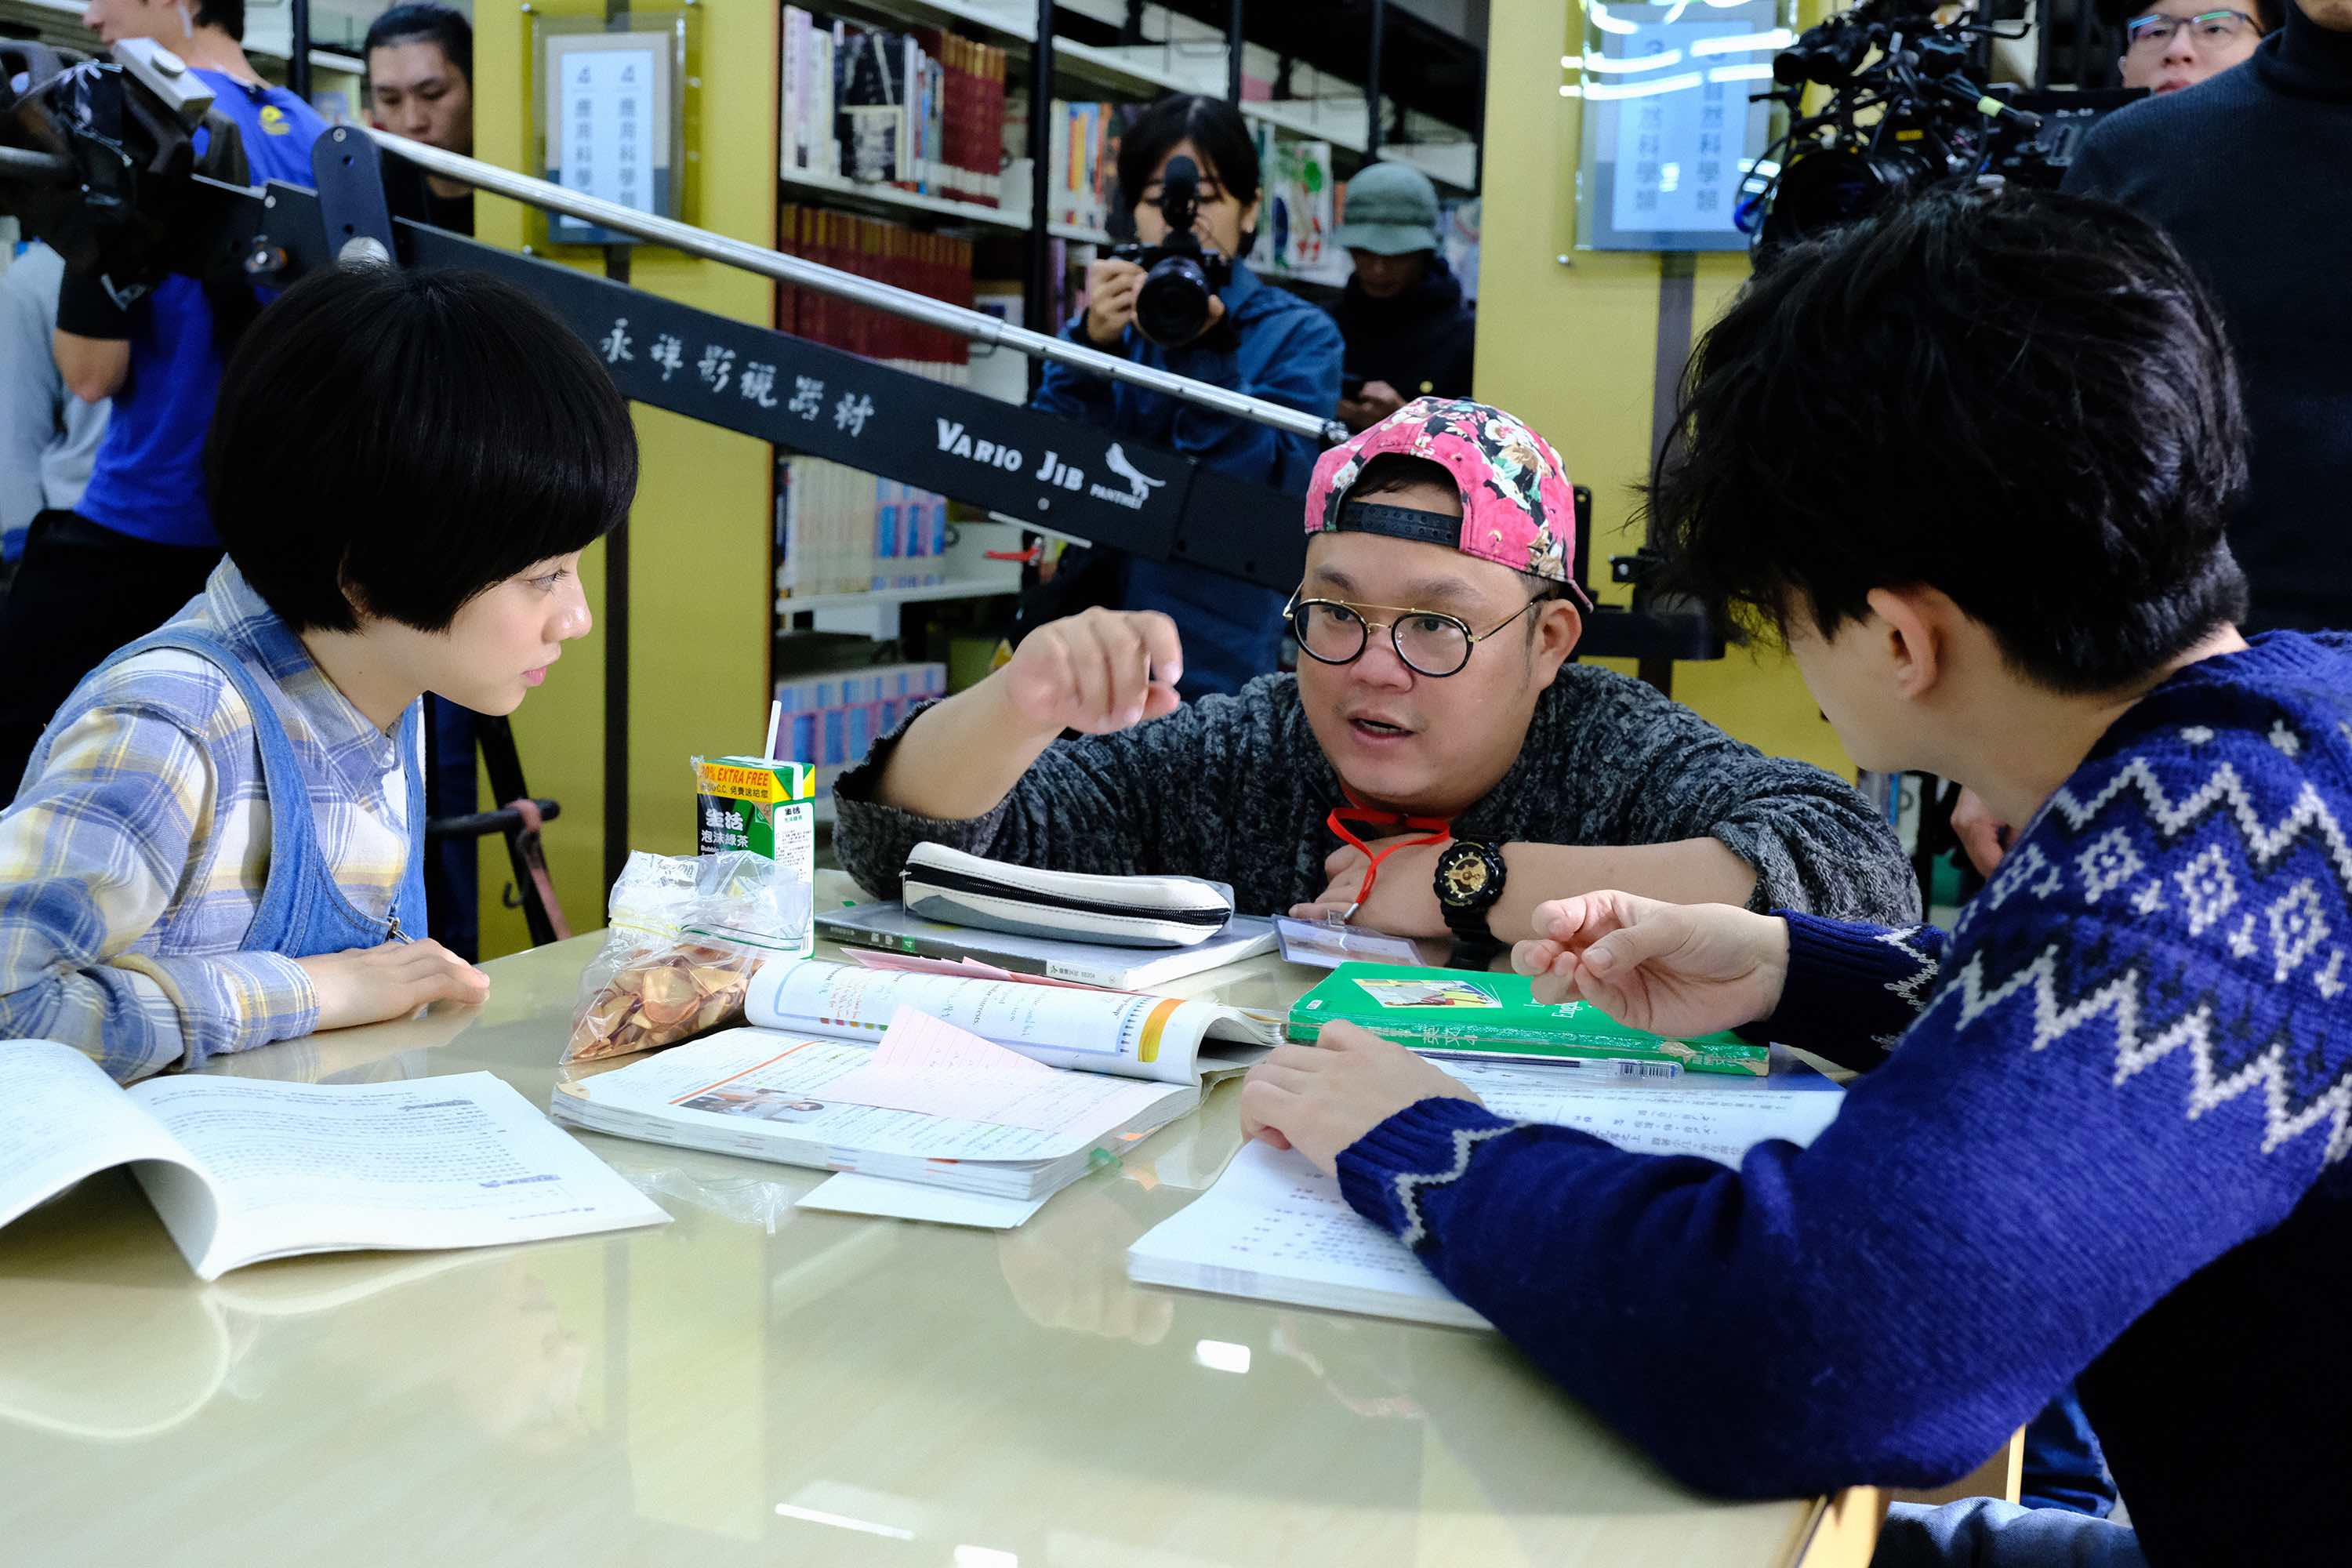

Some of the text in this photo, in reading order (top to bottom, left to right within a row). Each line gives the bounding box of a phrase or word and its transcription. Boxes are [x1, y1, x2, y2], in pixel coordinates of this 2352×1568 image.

[575, 97, 593, 194] 應用科學
[937, 418, 1084, 491] VARIO JIB
[717, 767, 743, 784] EXTRA
[746, 771, 769, 786] FREE
[706, 808, 743, 831] 生活
[701, 829, 749, 848] 泡沫綠茶
